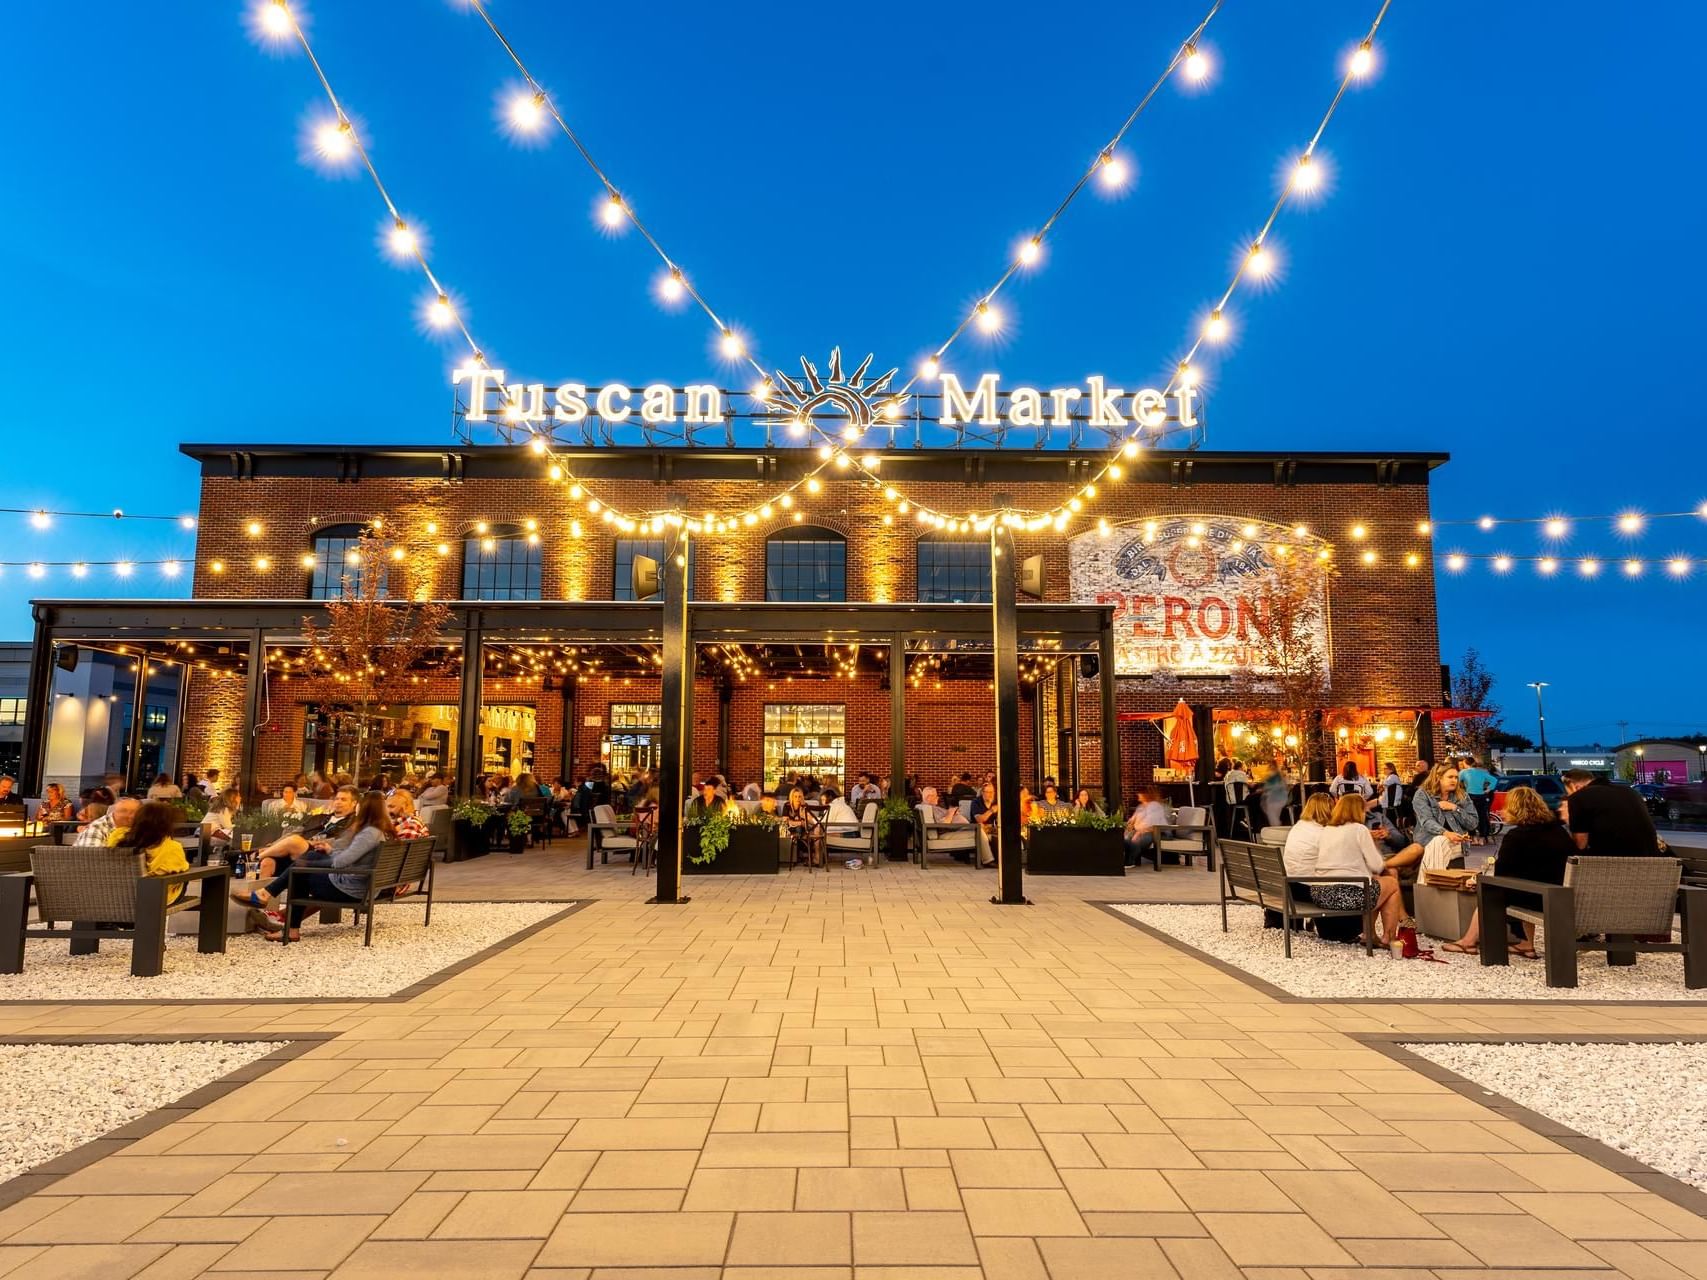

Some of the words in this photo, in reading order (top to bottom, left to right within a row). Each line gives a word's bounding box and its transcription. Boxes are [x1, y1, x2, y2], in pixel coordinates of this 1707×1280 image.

[452, 368, 725, 424] Tuscan
[938, 373, 1199, 427] Market
[1130, 560, 1150, 577] DAL
[1096, 592, 1280, 641] PERON
